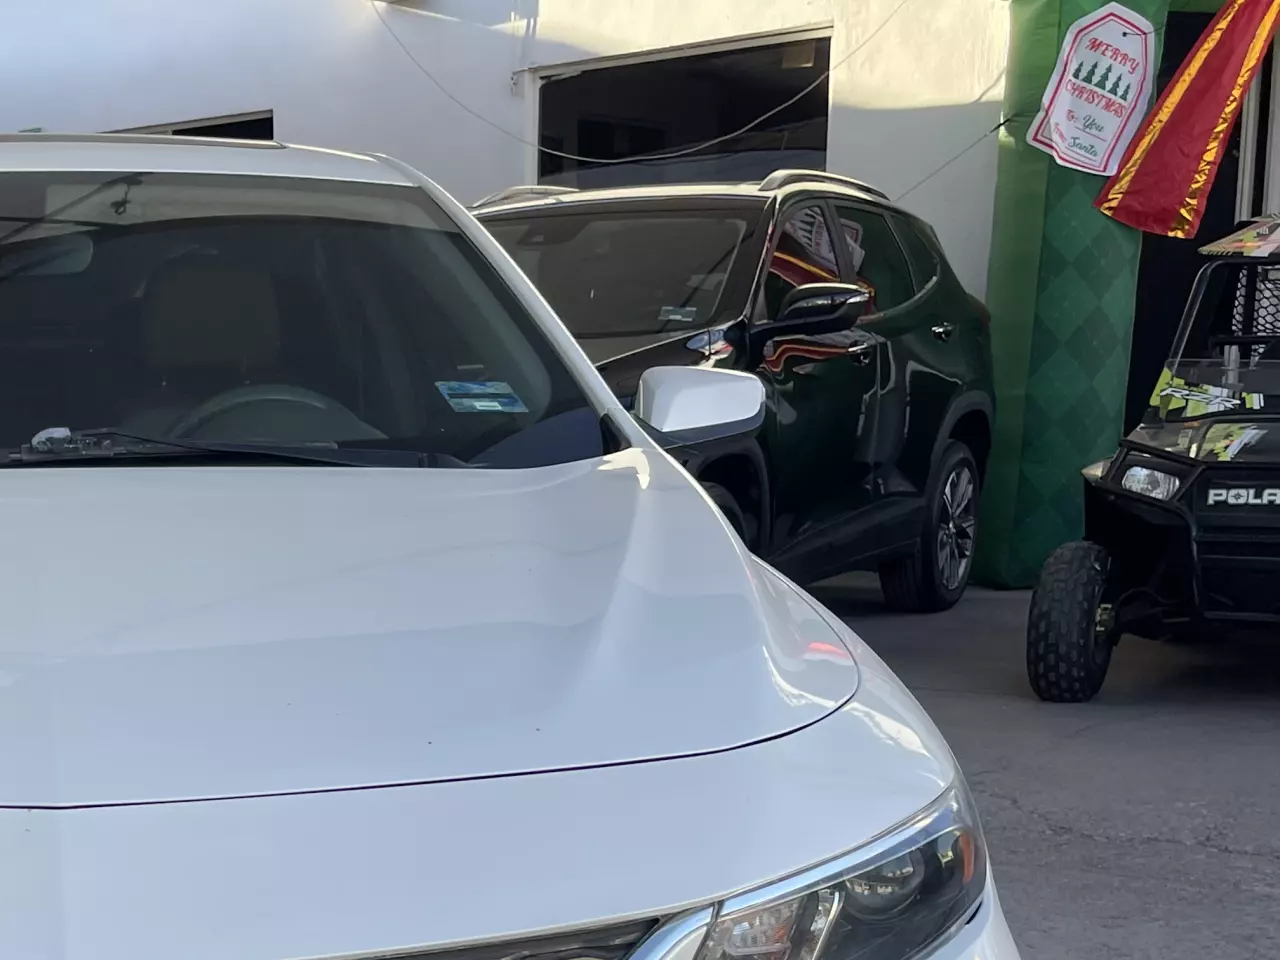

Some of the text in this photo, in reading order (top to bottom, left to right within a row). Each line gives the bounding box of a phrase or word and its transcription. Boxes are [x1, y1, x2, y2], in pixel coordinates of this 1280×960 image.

[1085, 37, 1139, 75] MERRY
[1065, 79, 1126, 118] CHRISTMAS
[1083, 114, 1104, 132] You
